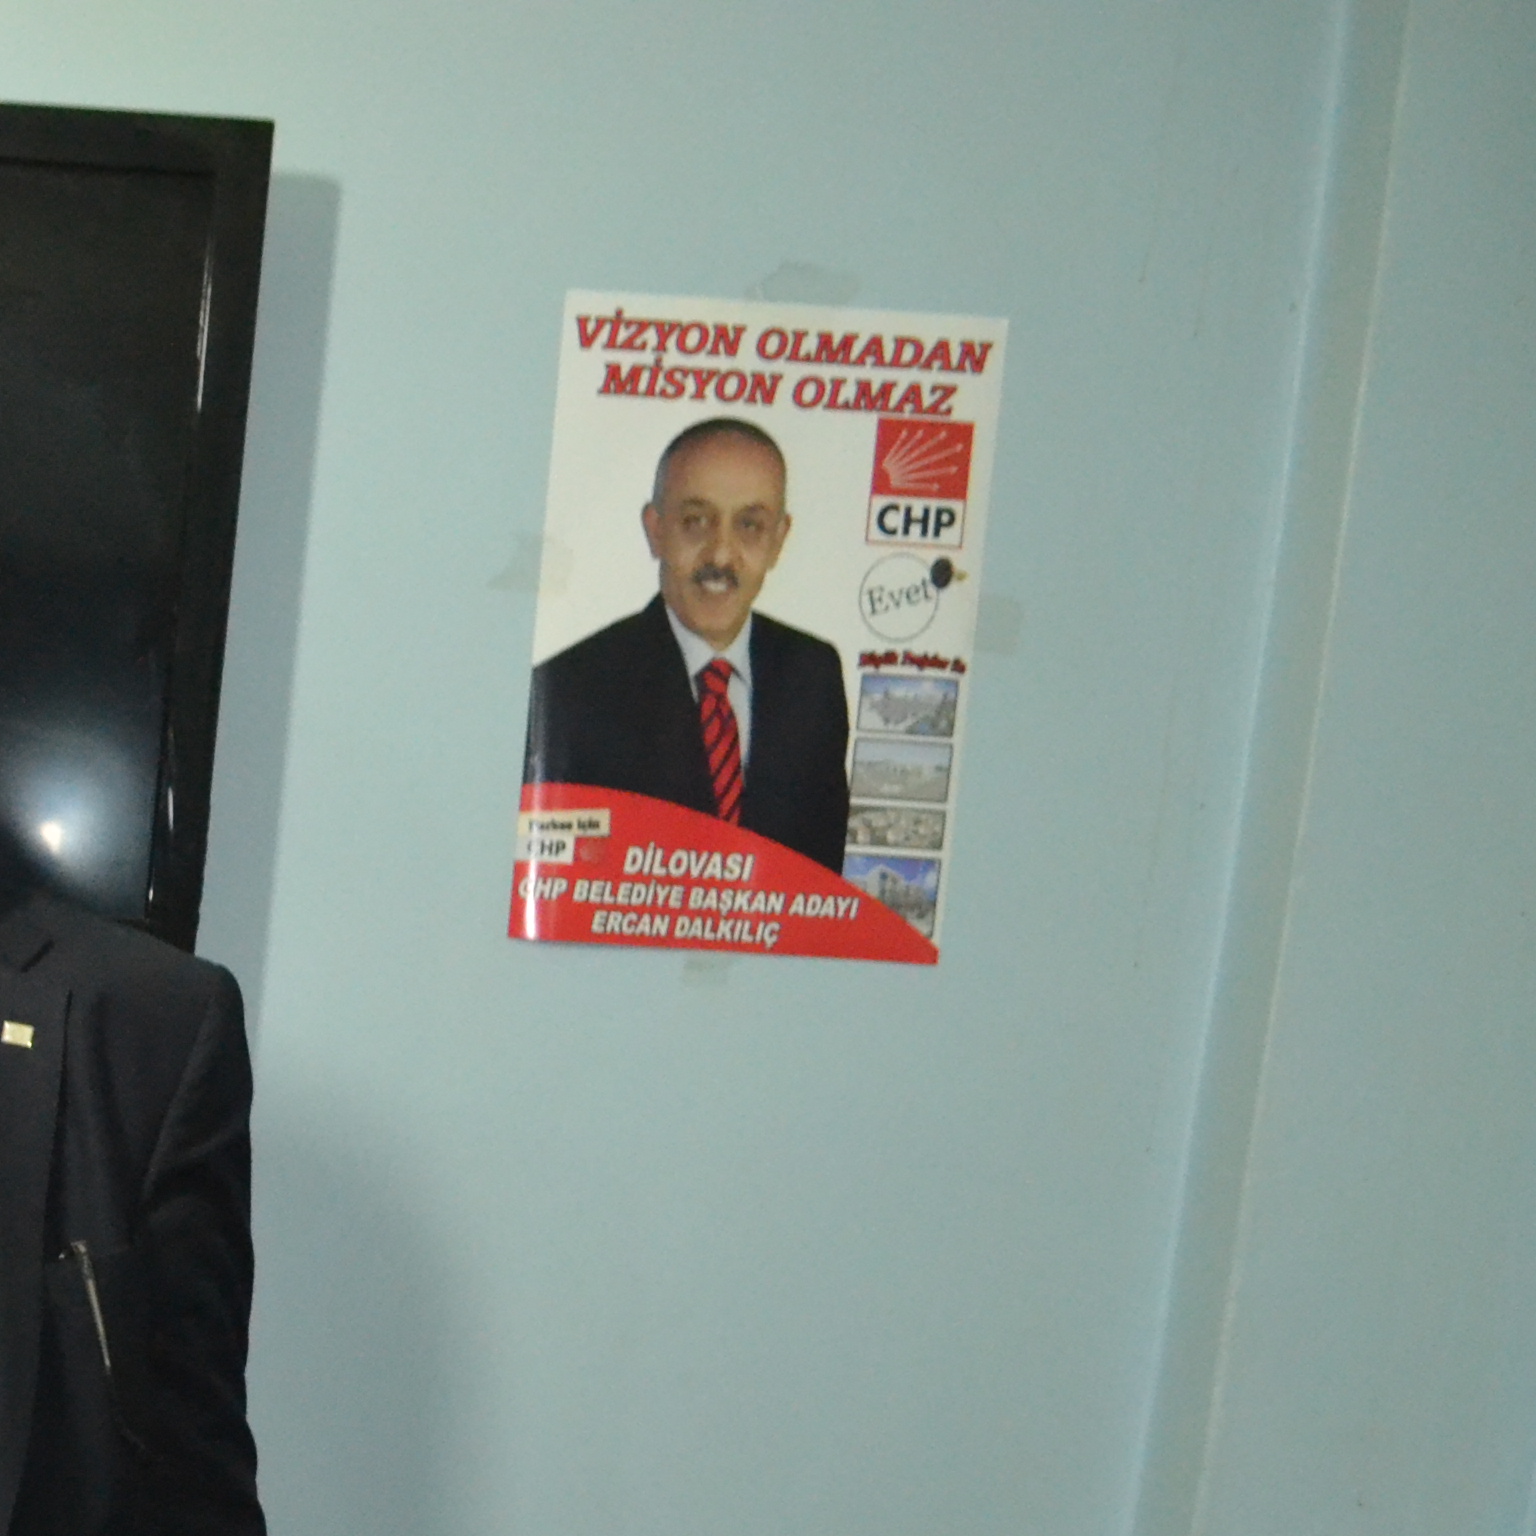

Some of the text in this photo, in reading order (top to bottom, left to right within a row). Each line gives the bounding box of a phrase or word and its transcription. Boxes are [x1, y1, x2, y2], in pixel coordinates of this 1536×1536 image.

[575, 308, 993, 375] VİZYON OLMADAN
[598, 354, 958, 417] MİSYON OLMAZ
[876, 503, 956, 538] CHP
[866, 577, 932, 616] Evet
[624, 842, 755, 883] DİLOVASI
[518, 876, 860, 920] CHP BELEDİYE BAŞKAN ADAYI
[591, 910, 781, 948] ERCAN DALKILIÇ
